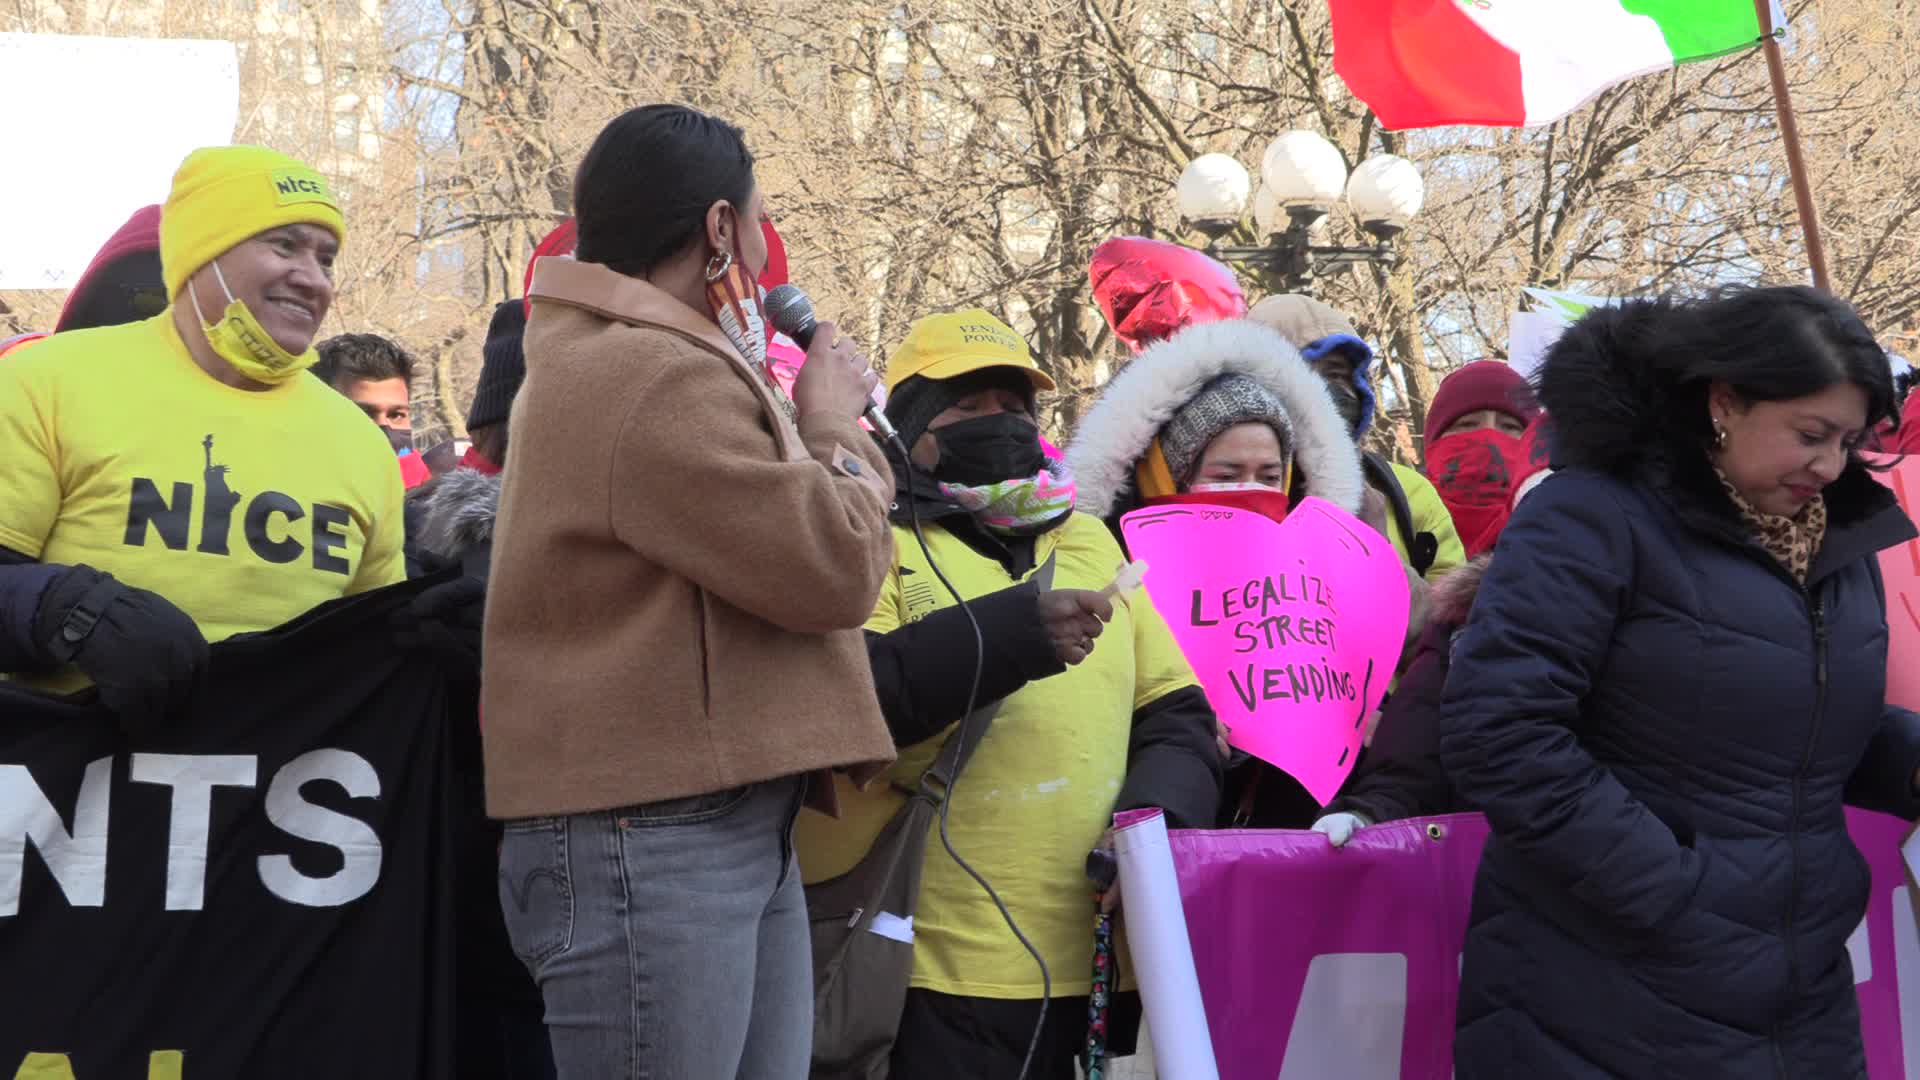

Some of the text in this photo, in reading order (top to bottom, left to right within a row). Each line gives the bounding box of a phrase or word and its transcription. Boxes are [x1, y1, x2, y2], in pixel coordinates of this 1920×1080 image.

[276, 176, 321, 194] NICE
[123, 433, 350, 576] NICE
[1191, 559, 1337, 626] LEGALIZE
[1234, 615, 1336, 653] STREET
